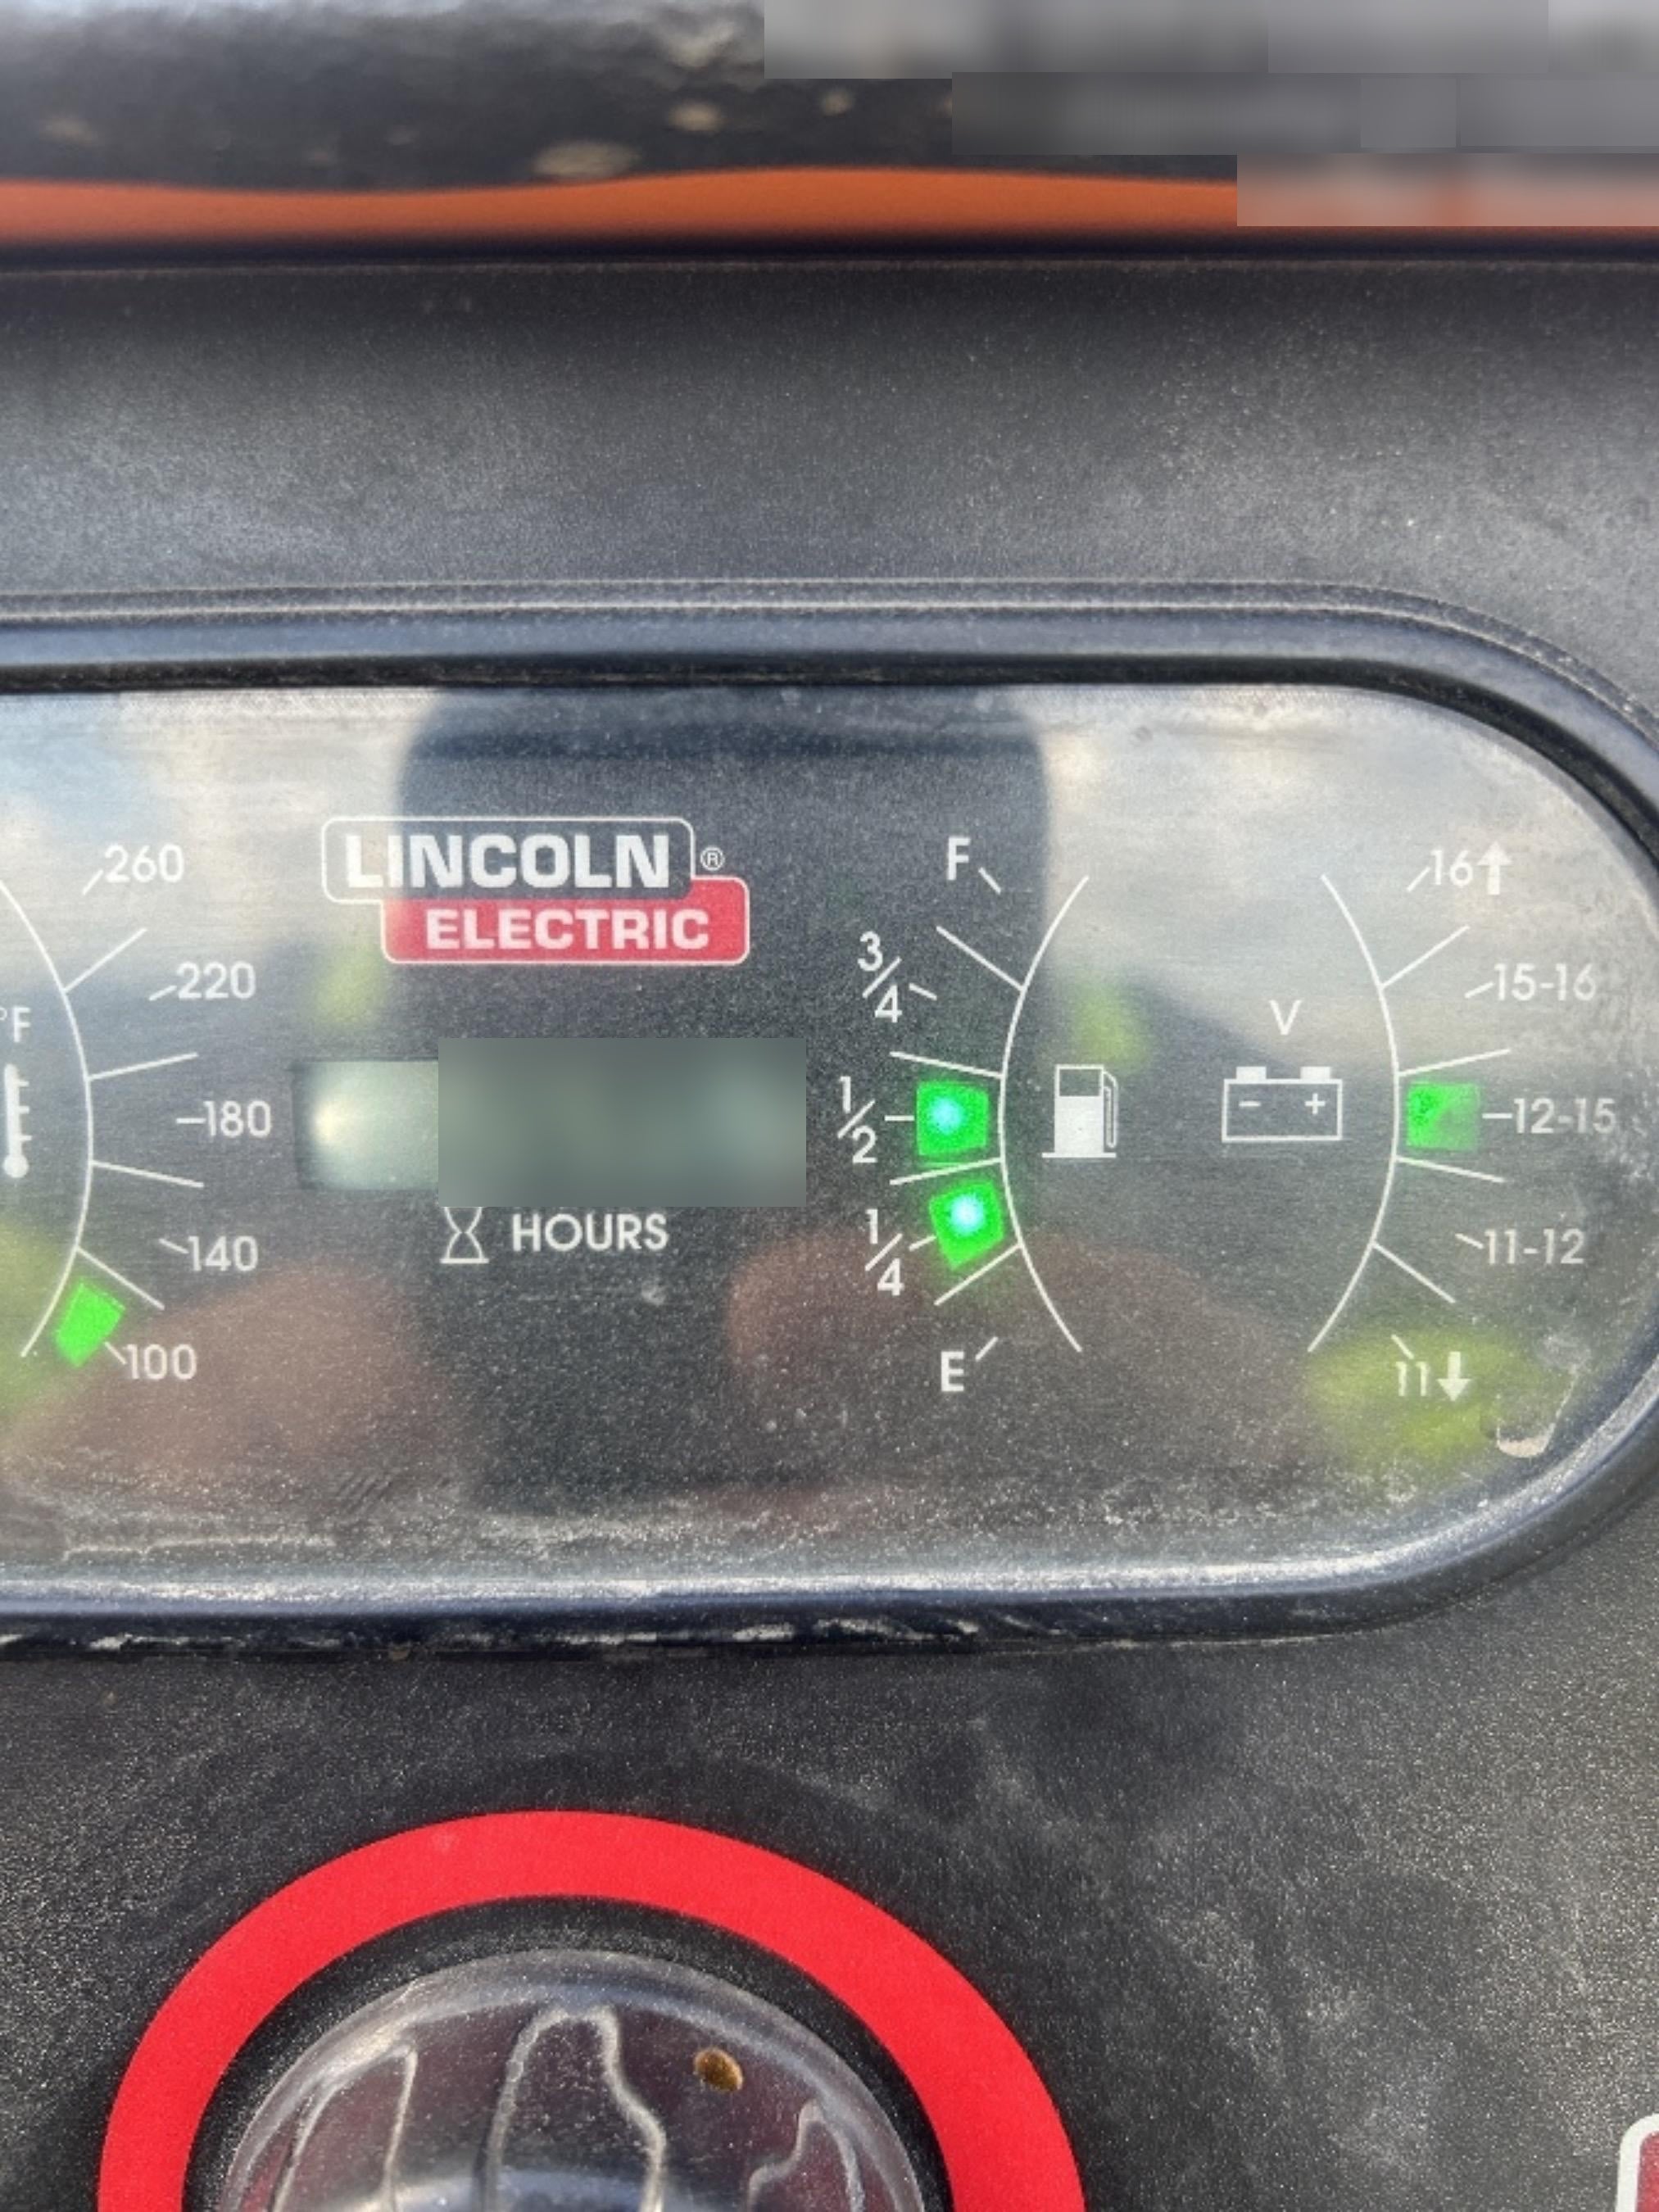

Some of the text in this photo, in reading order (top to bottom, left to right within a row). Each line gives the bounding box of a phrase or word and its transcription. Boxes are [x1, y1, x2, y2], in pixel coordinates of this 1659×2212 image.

[104, 844, 184, 885] 260
[345, 833, 669, 889] LINCOLN
[945, 836, 971, 881] F
[1430, 849, 1473, 886] 16
[425, 909, 709, 950] ELECTRIC
[175, 962, 256, 999] 220
[1493, 963, 1597, 1001] 15-16
[1270, 999, 1301, 1035] V
[204, 1099, 271, 1137] 180
[1513, 1098, 1616, 1134] 12-15
[511, 1213, 669, 1252] HOURS
[1484, 1229, 1584, 1265] 11-12
[188, 1235, 258, 1271] 140
[125, 1344, 197, 1380] 100
[941, 1352, 964, 1392] E
[1395, 1362, 1430, 1396] 11
